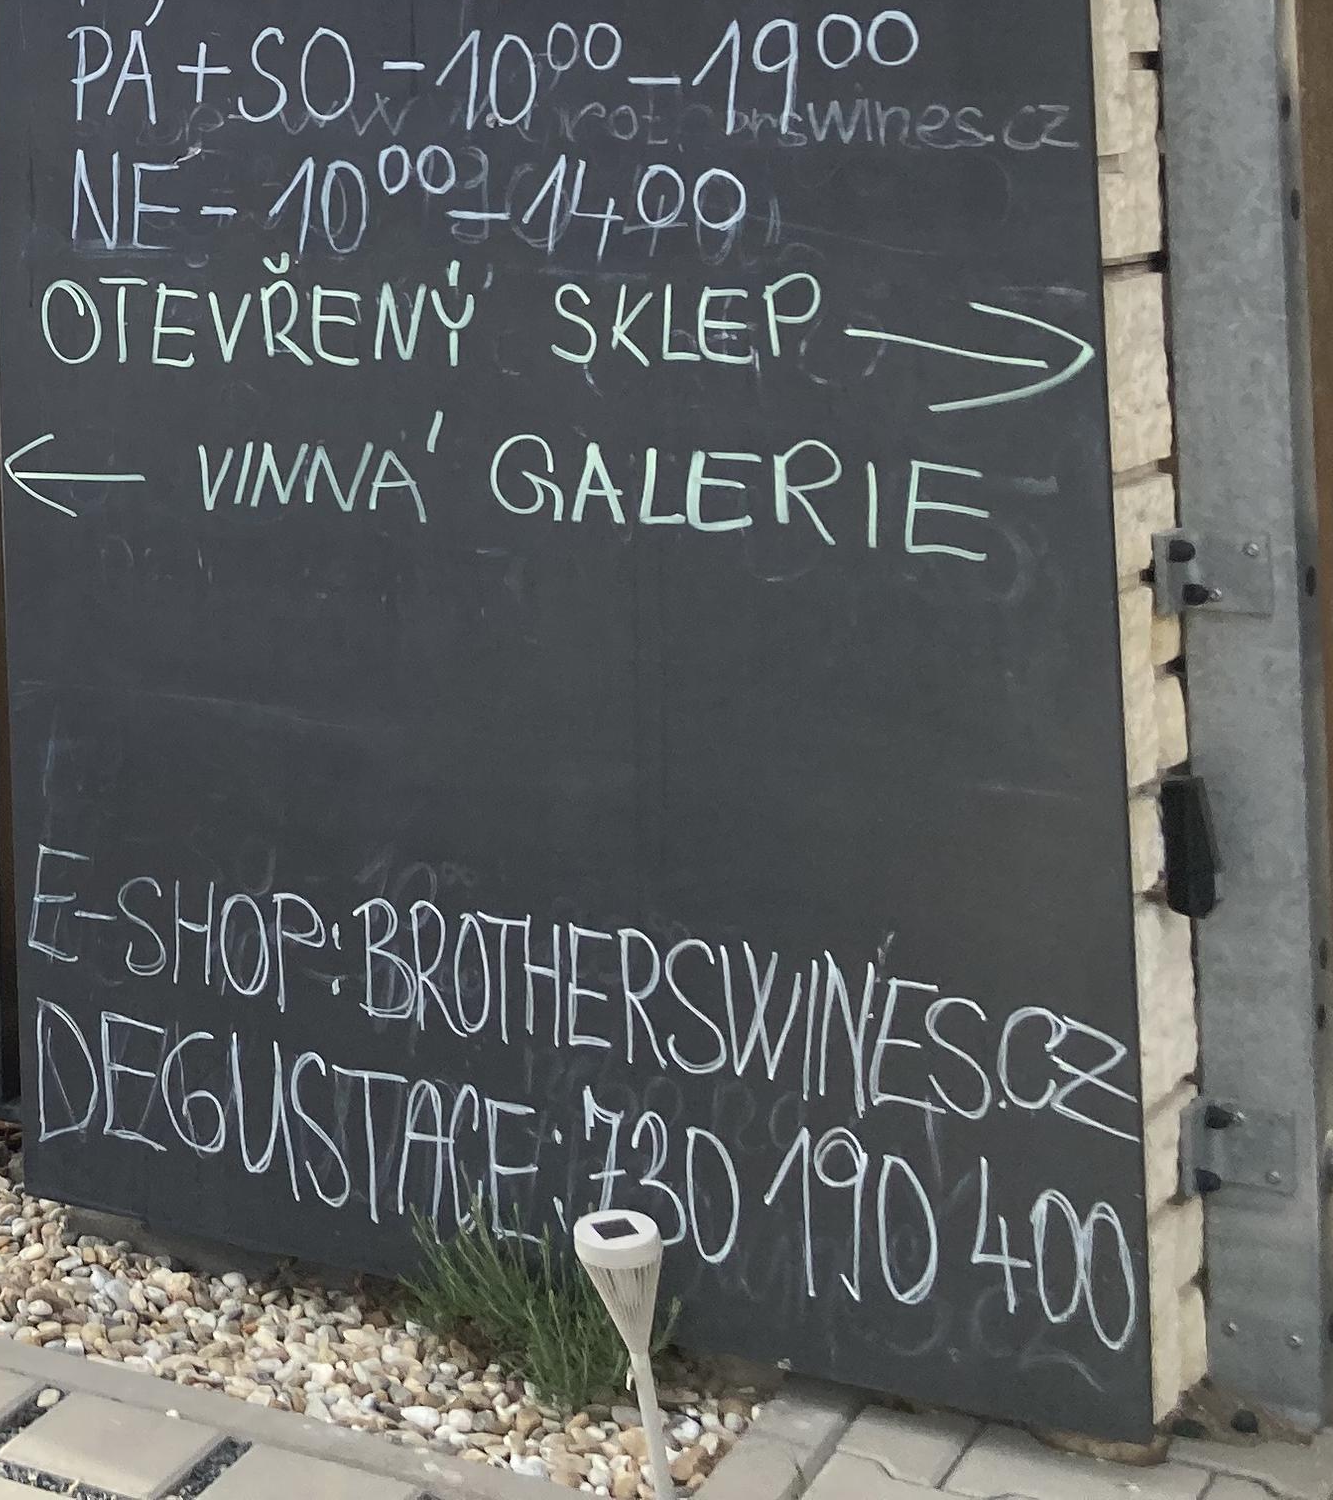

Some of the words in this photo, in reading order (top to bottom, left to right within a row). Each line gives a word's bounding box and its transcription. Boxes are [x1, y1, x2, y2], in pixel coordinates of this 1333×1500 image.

[237, 26, 356, 126] SO
[71, 148, 181, 250] NE
[41, 251, 475, 368] OTEVŘENÝ
[550, 272, 821, 368] SKLEP
[197, 410, 444, 523] VINNÁ
[489, 434, 990, 561] GALERIE
[582, 1084, 741, 1264] 730
[763, 1125, 939, 1305] 190
[970, 1156, 1136, 1351] 400
